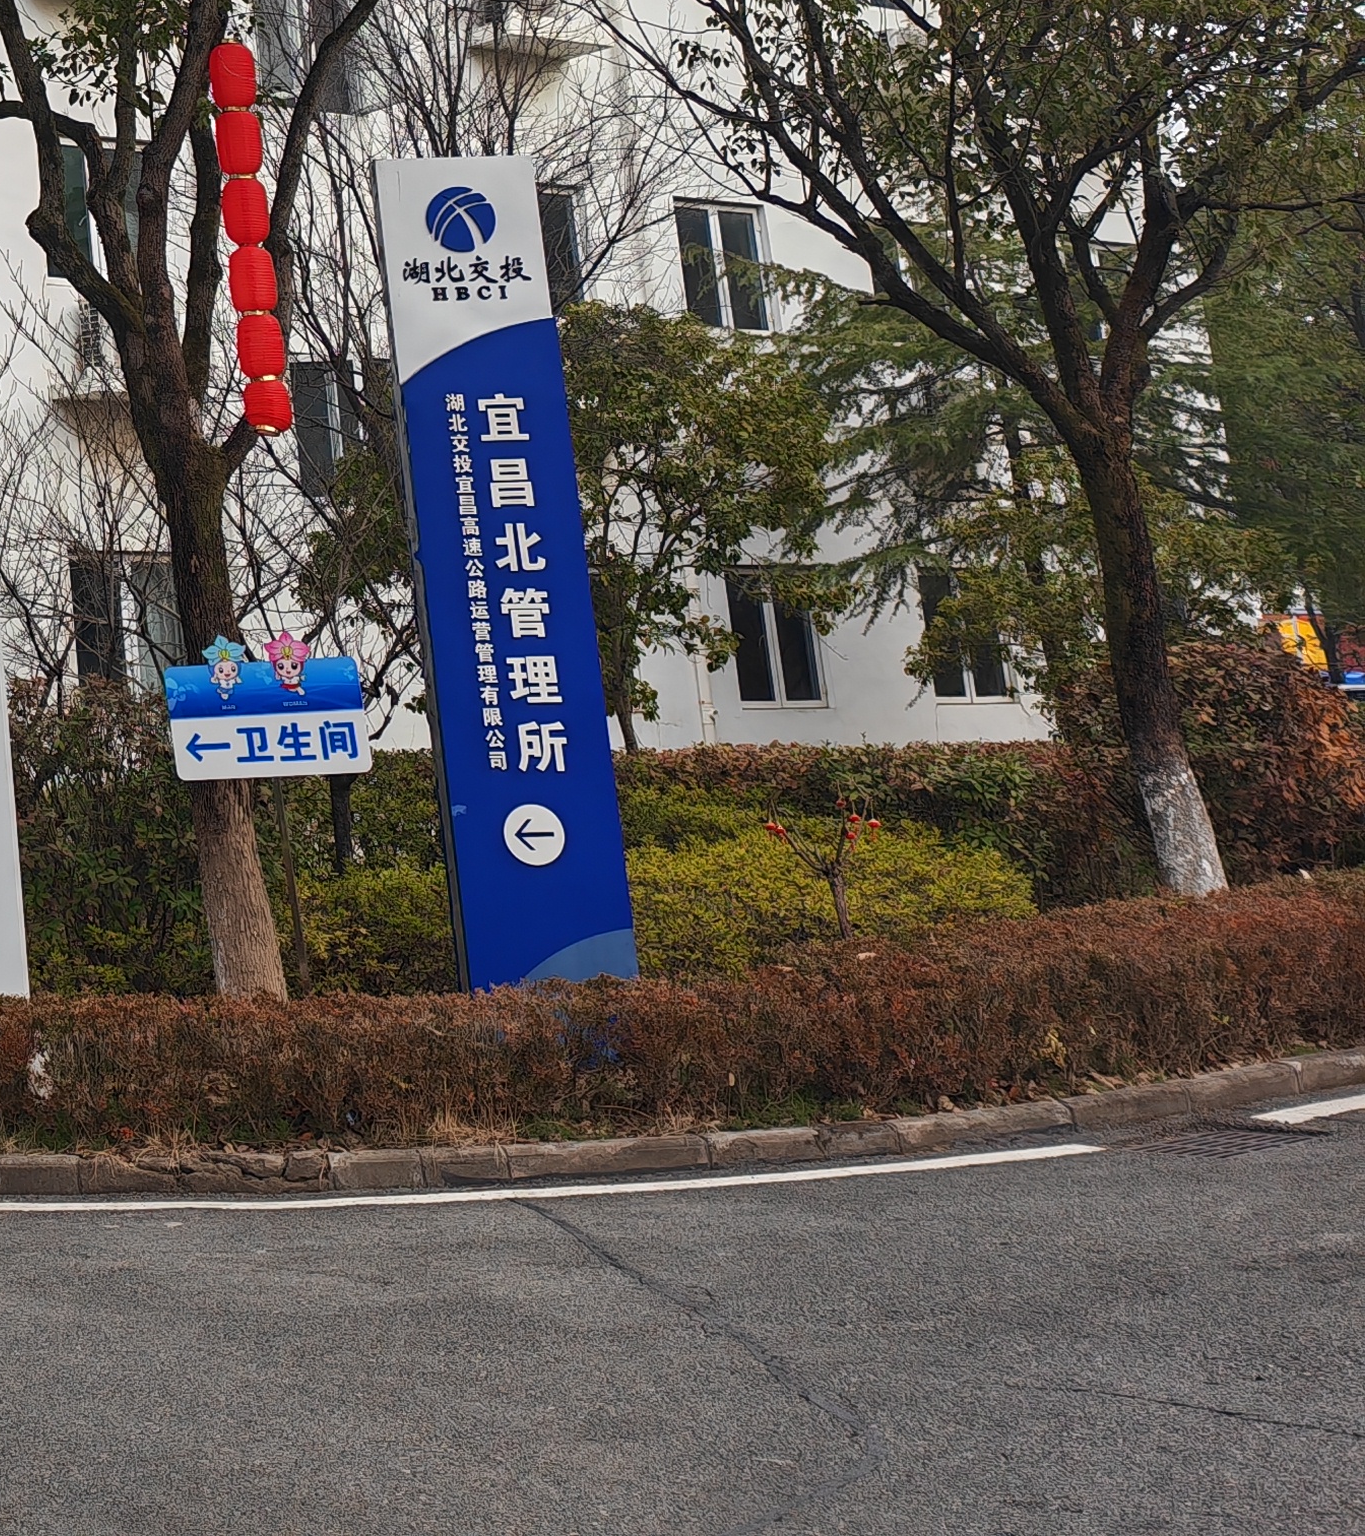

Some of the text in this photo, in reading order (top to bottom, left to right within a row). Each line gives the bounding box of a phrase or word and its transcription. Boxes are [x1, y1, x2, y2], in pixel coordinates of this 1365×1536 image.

[403, 256, 531, 284] 湖北交投
[432, 287, 508, 301] HBCI
[445, 393, 508, 771] 湖北交投宜昌高速公路运营管理有限公司
[477, 393, 568, 773] 宜昌北管理所
[237, 721, 358, 762] 卫生间
